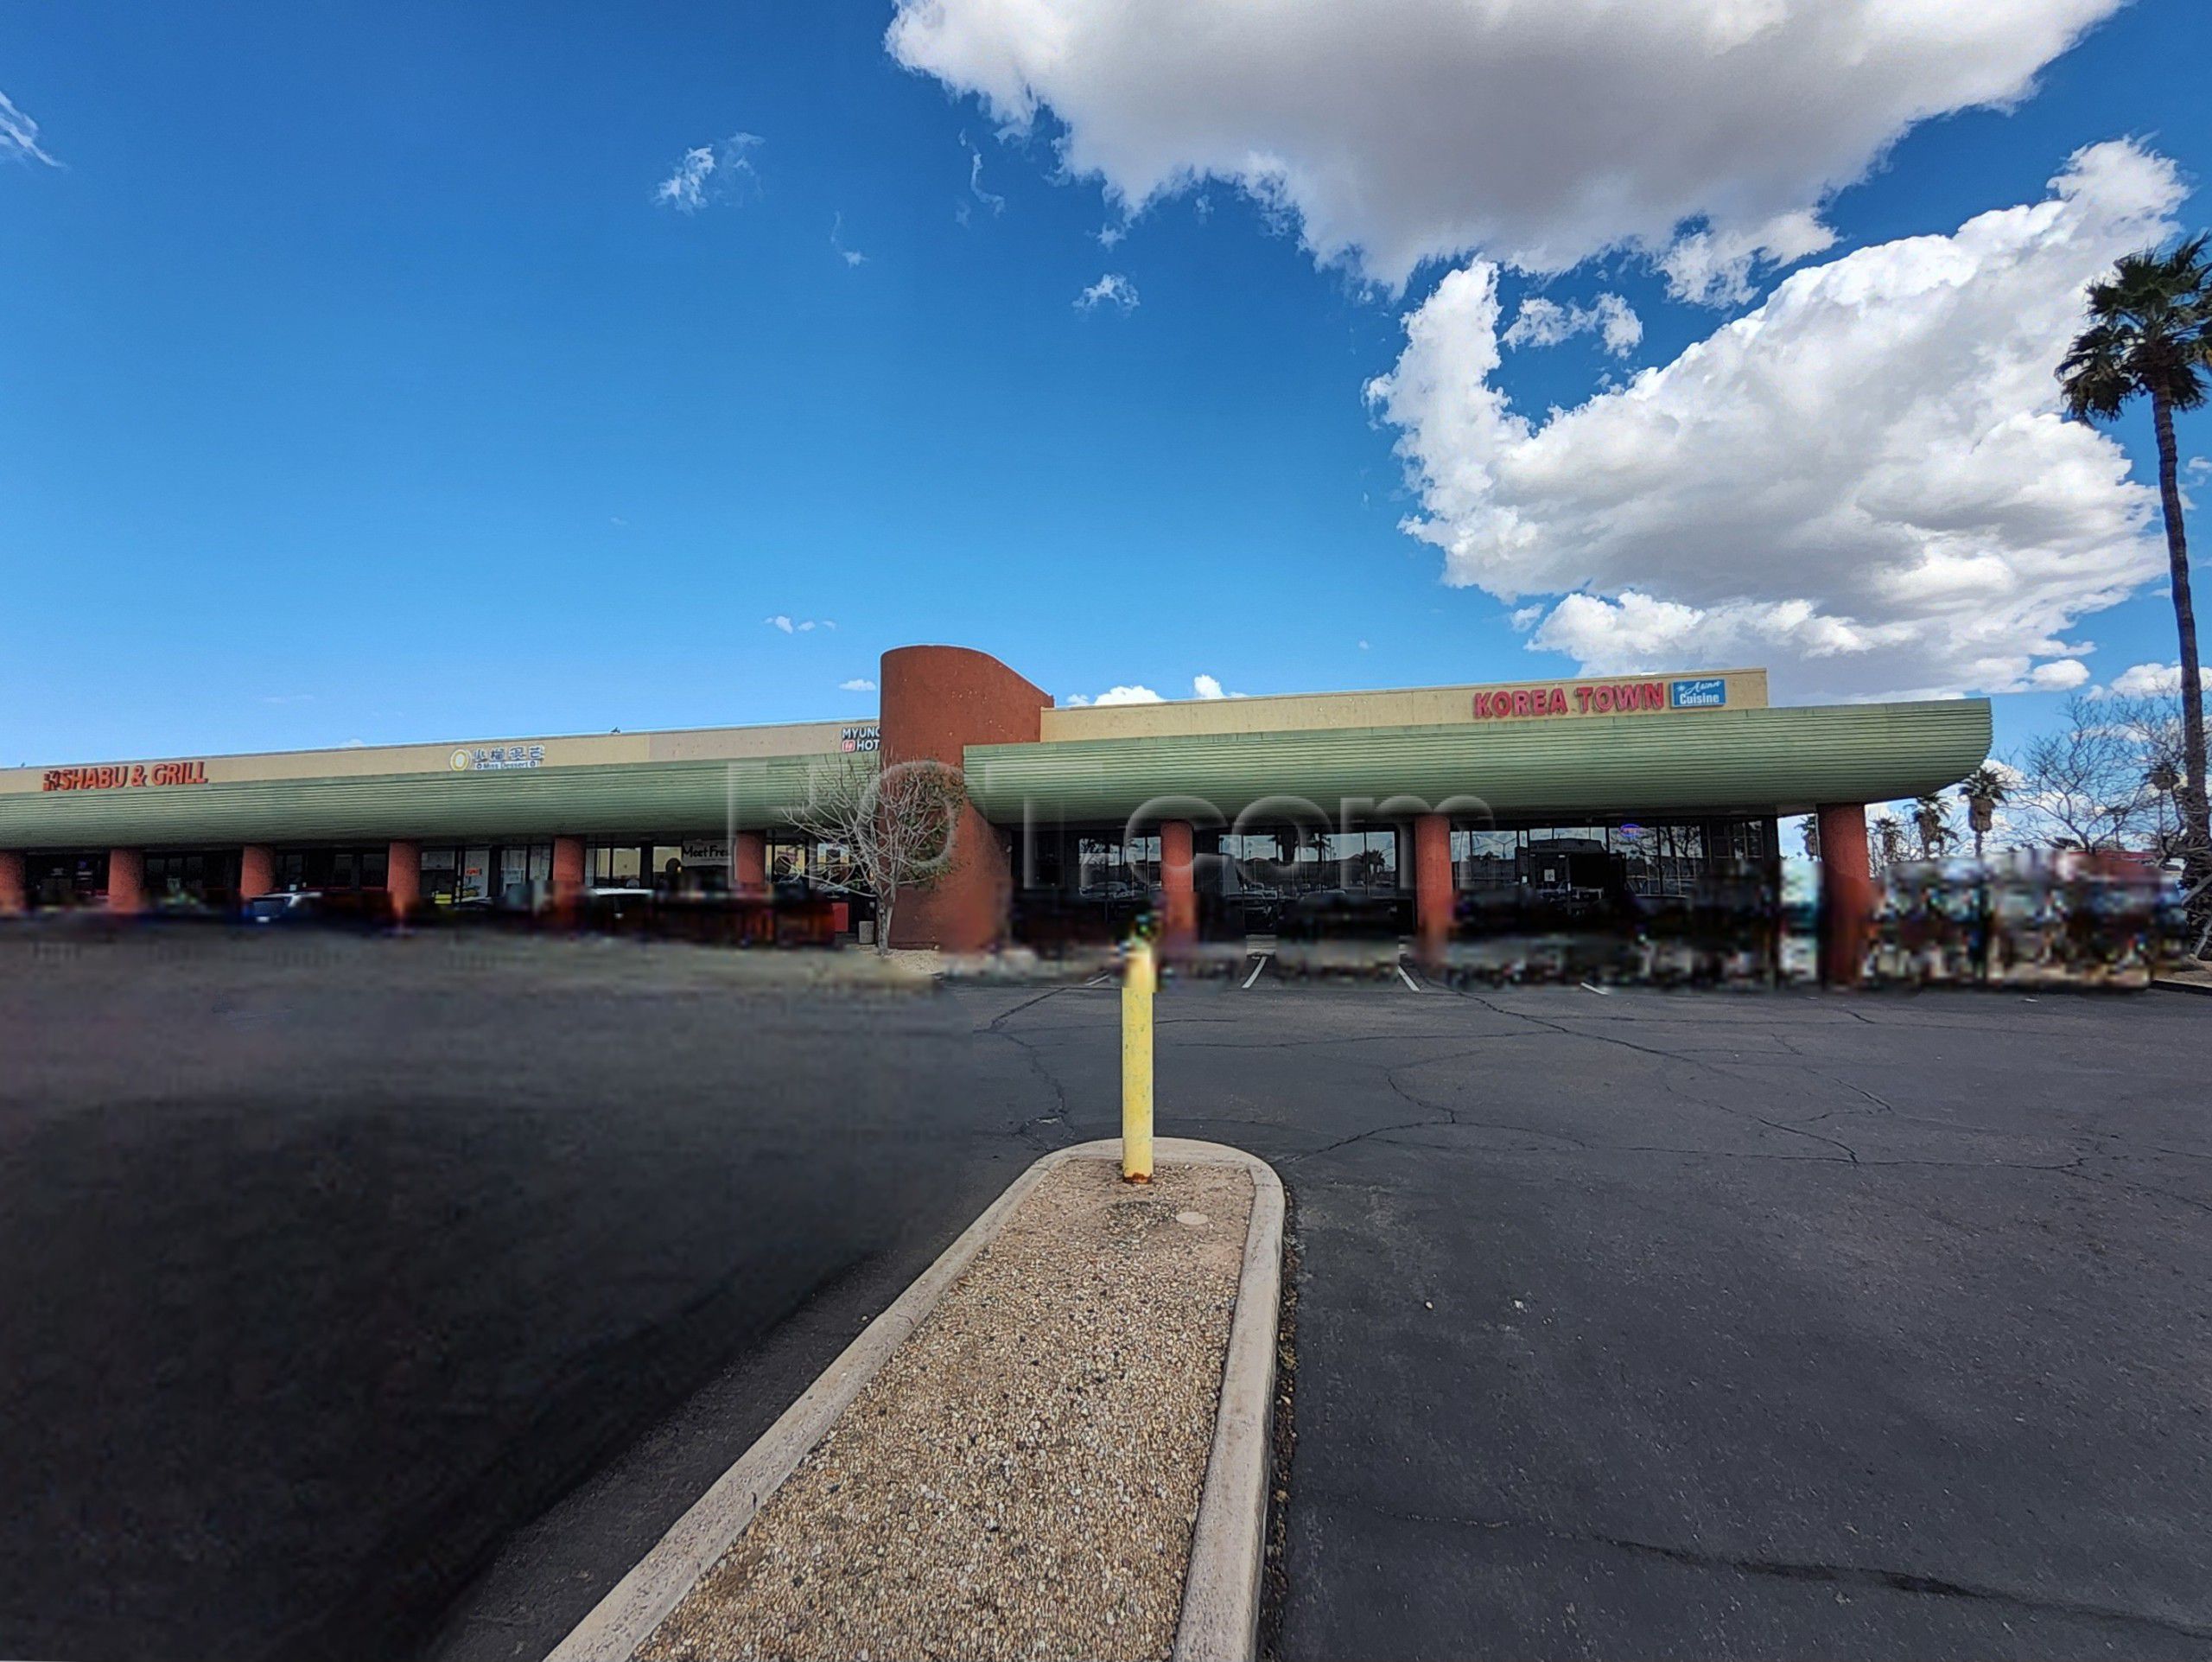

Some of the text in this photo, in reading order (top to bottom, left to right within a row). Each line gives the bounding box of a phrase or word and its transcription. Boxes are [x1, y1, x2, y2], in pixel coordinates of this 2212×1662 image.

[1473, 682, 1664, 718] KOREA TOWN
[1680, 692, 1719, 704] Cuisine
[60, 766, 129, 790] SHABU
[130, 765, 147, 787] &
[150, 761, 208, 786] GRILL
